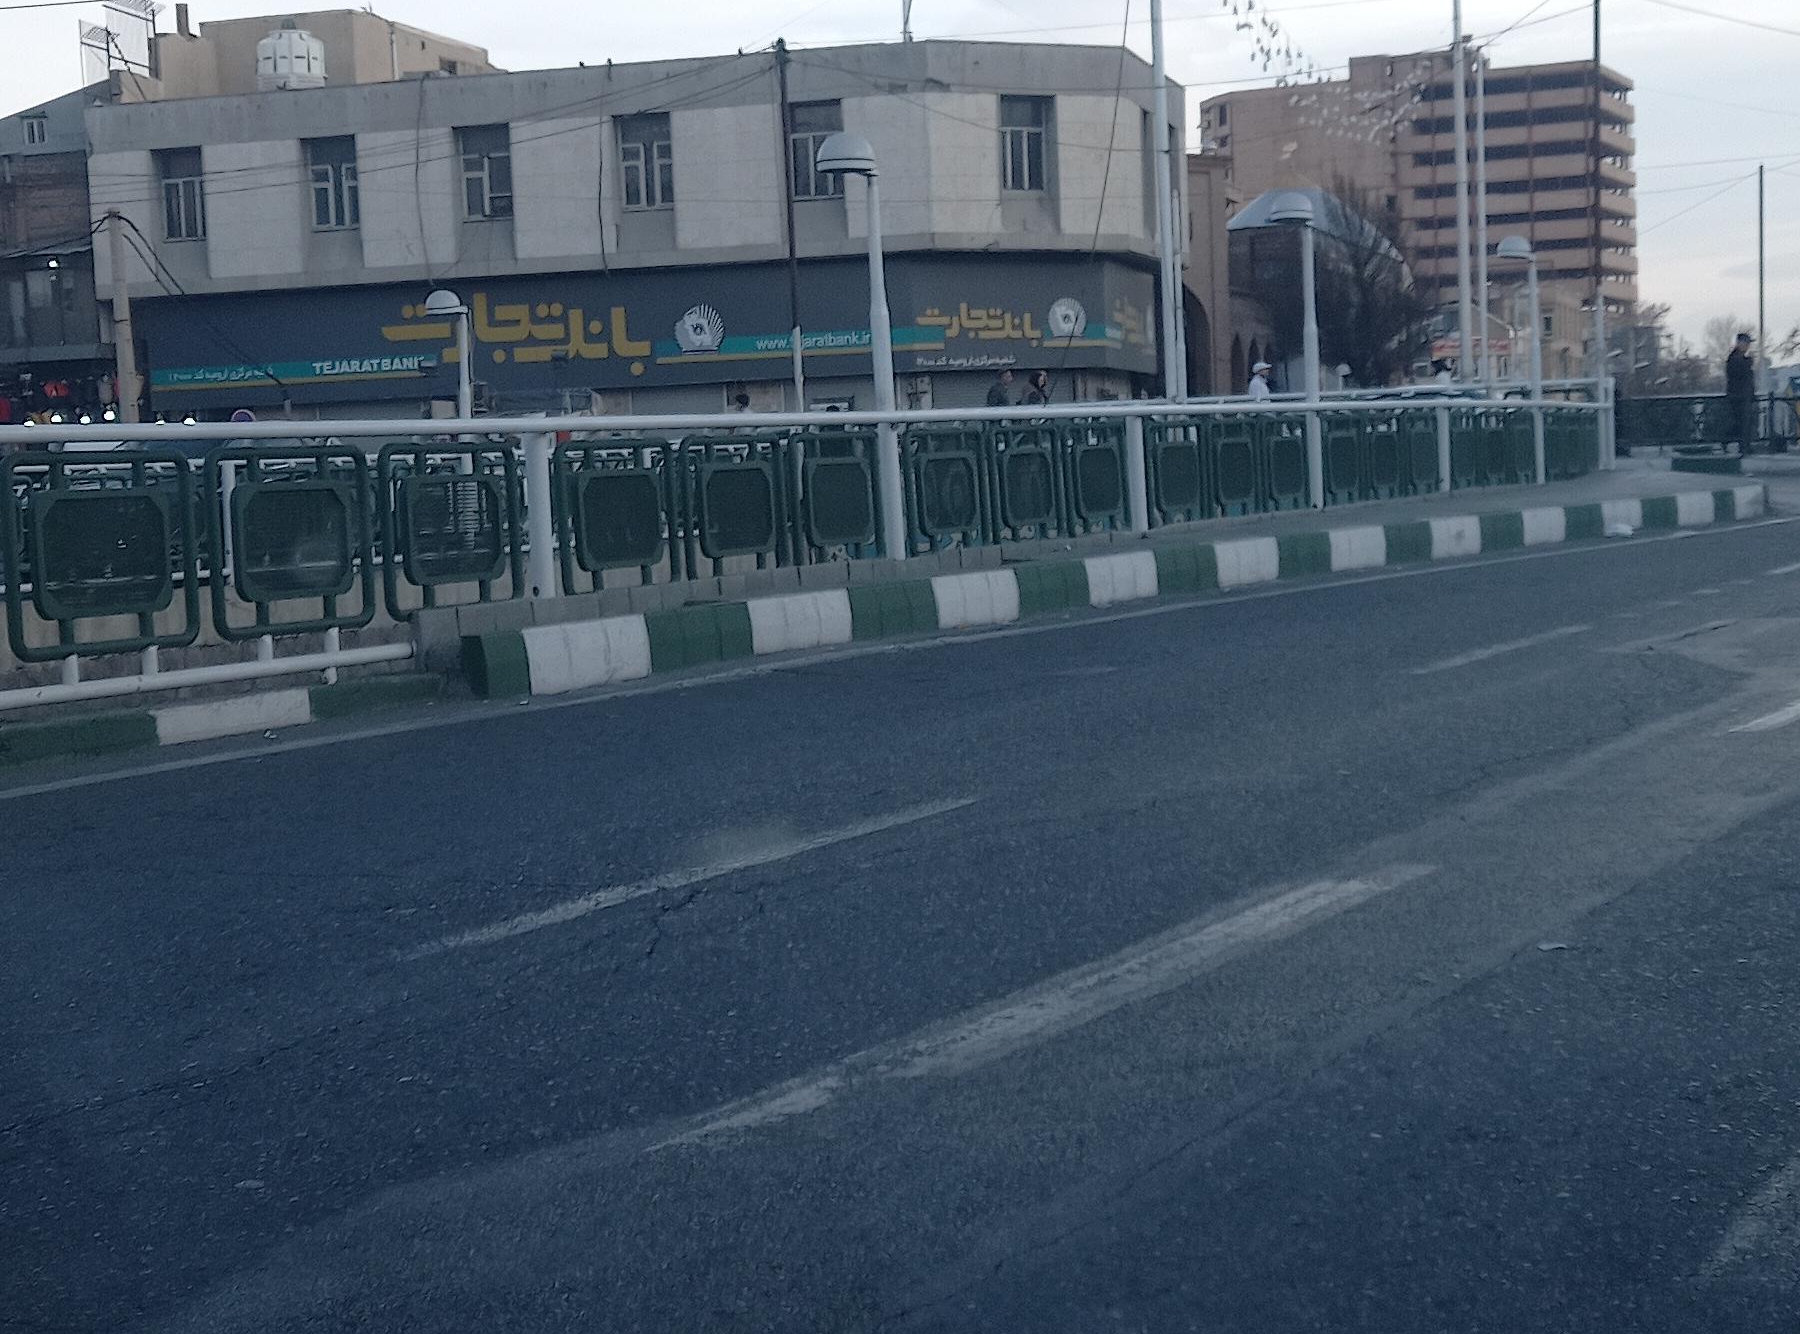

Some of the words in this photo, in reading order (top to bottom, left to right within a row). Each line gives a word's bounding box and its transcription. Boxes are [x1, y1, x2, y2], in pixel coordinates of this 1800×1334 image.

[916, 302, 1003, 339] تجارت
[978, 312, 1042, 347] بانک
[514, 307, 651, 376] بانک
